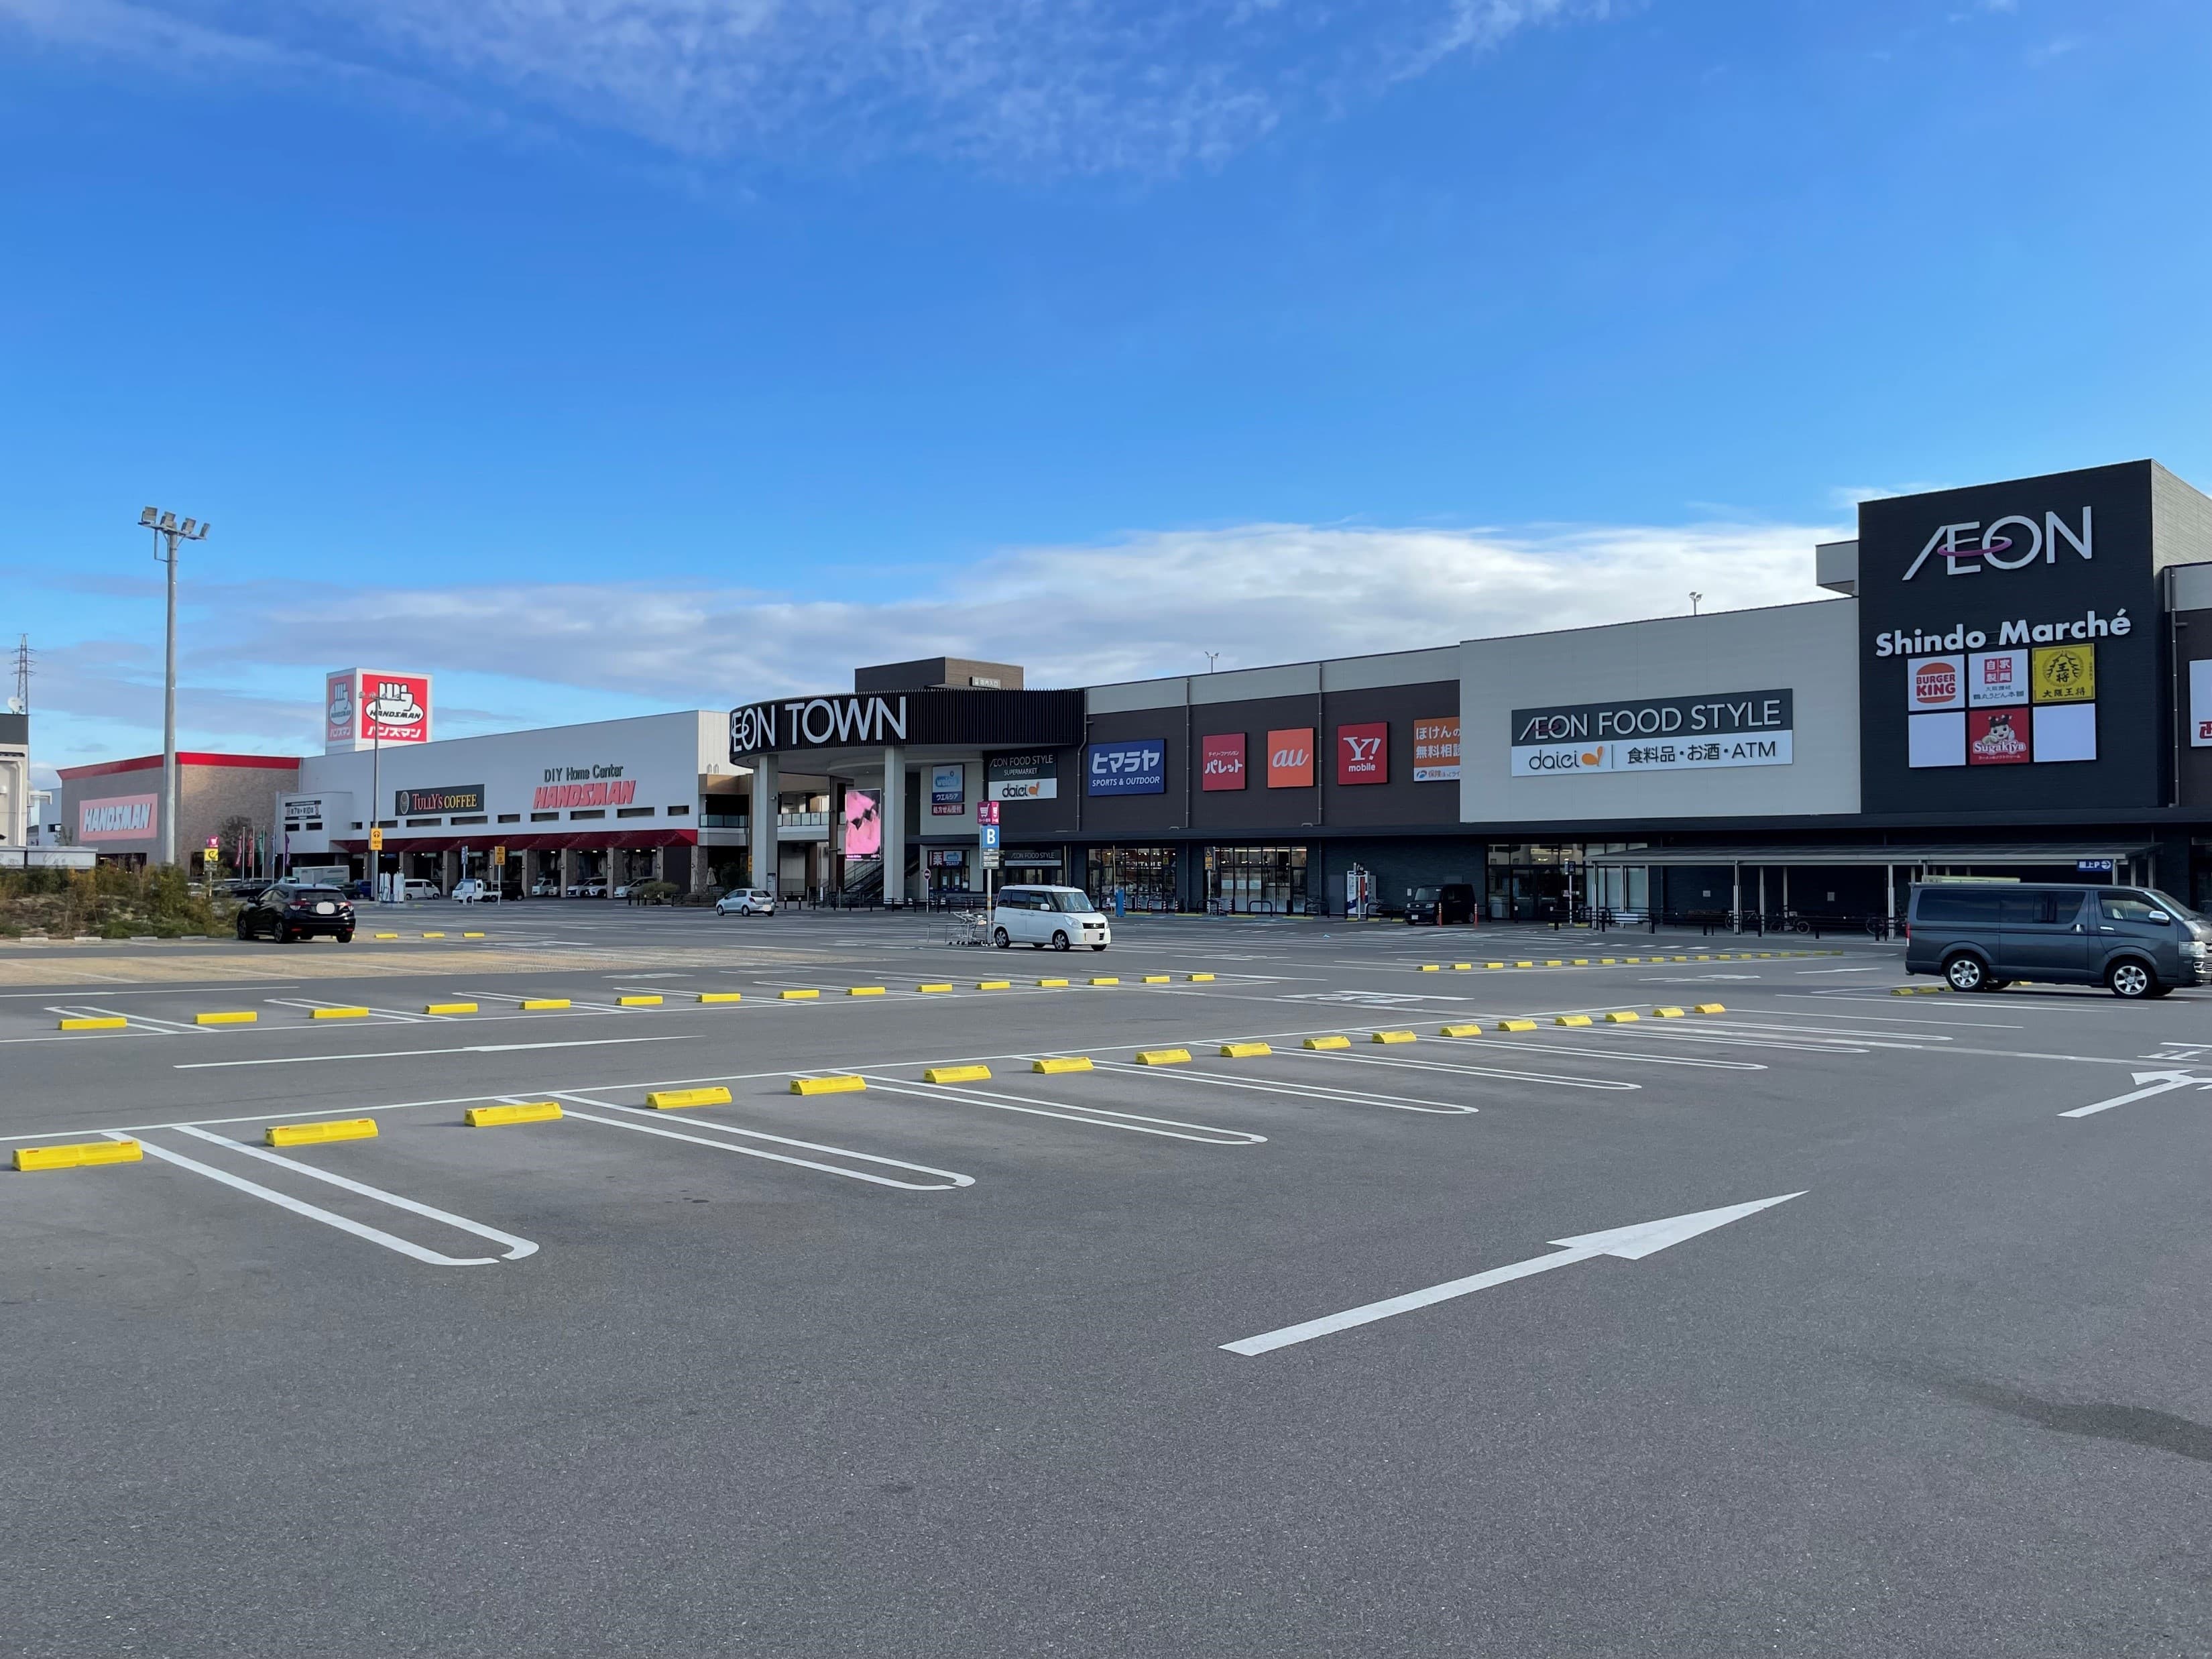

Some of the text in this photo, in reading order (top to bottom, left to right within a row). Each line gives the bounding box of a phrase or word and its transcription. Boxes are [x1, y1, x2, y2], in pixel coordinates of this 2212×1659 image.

[1875, 608, 2132, 656] Shindo Marché
[1916, 674, 1955, 685] BURGER
[1916, 683, 1956, 697] KING
[2042, 687, 2085, 698] 大阪王将
[369, 709, 421, 720] HANDSMAN
[784, 696, 907, 745] TOWN
[1598, 707, 1682, 736] FOOD
[1690, 699, 1782, 730] STYLE
[367, 726, 422, 738] ハンズマン
[1343, 737, 1381, 761] Y!
[1973, 740, 2025, 754] Sugakiya
[1010, 756, 1030, 766] FOOD
[1032, 754, 1053, 764] STYLE
[1092, 749, 1160, 775] ヒマラヤ
[1272, 748, 1309, 768] au
[544, 764, 624, 783] DIY Home Center
[1004, 767, 1038, 776] SUPERMARKET
[1204, 758, 1243, 775] パレット
[1348, 763, 1376, 772] mobile
[1092, 776, 1160, 787] SPORTS & OUTDOOR
[444, 794, 477, 808] COFFEE
[533, 780, 636, 809] HANDSMAN
[84, 804, 152, 832] HANDSMAN
[987, 828, 996, 844] B
